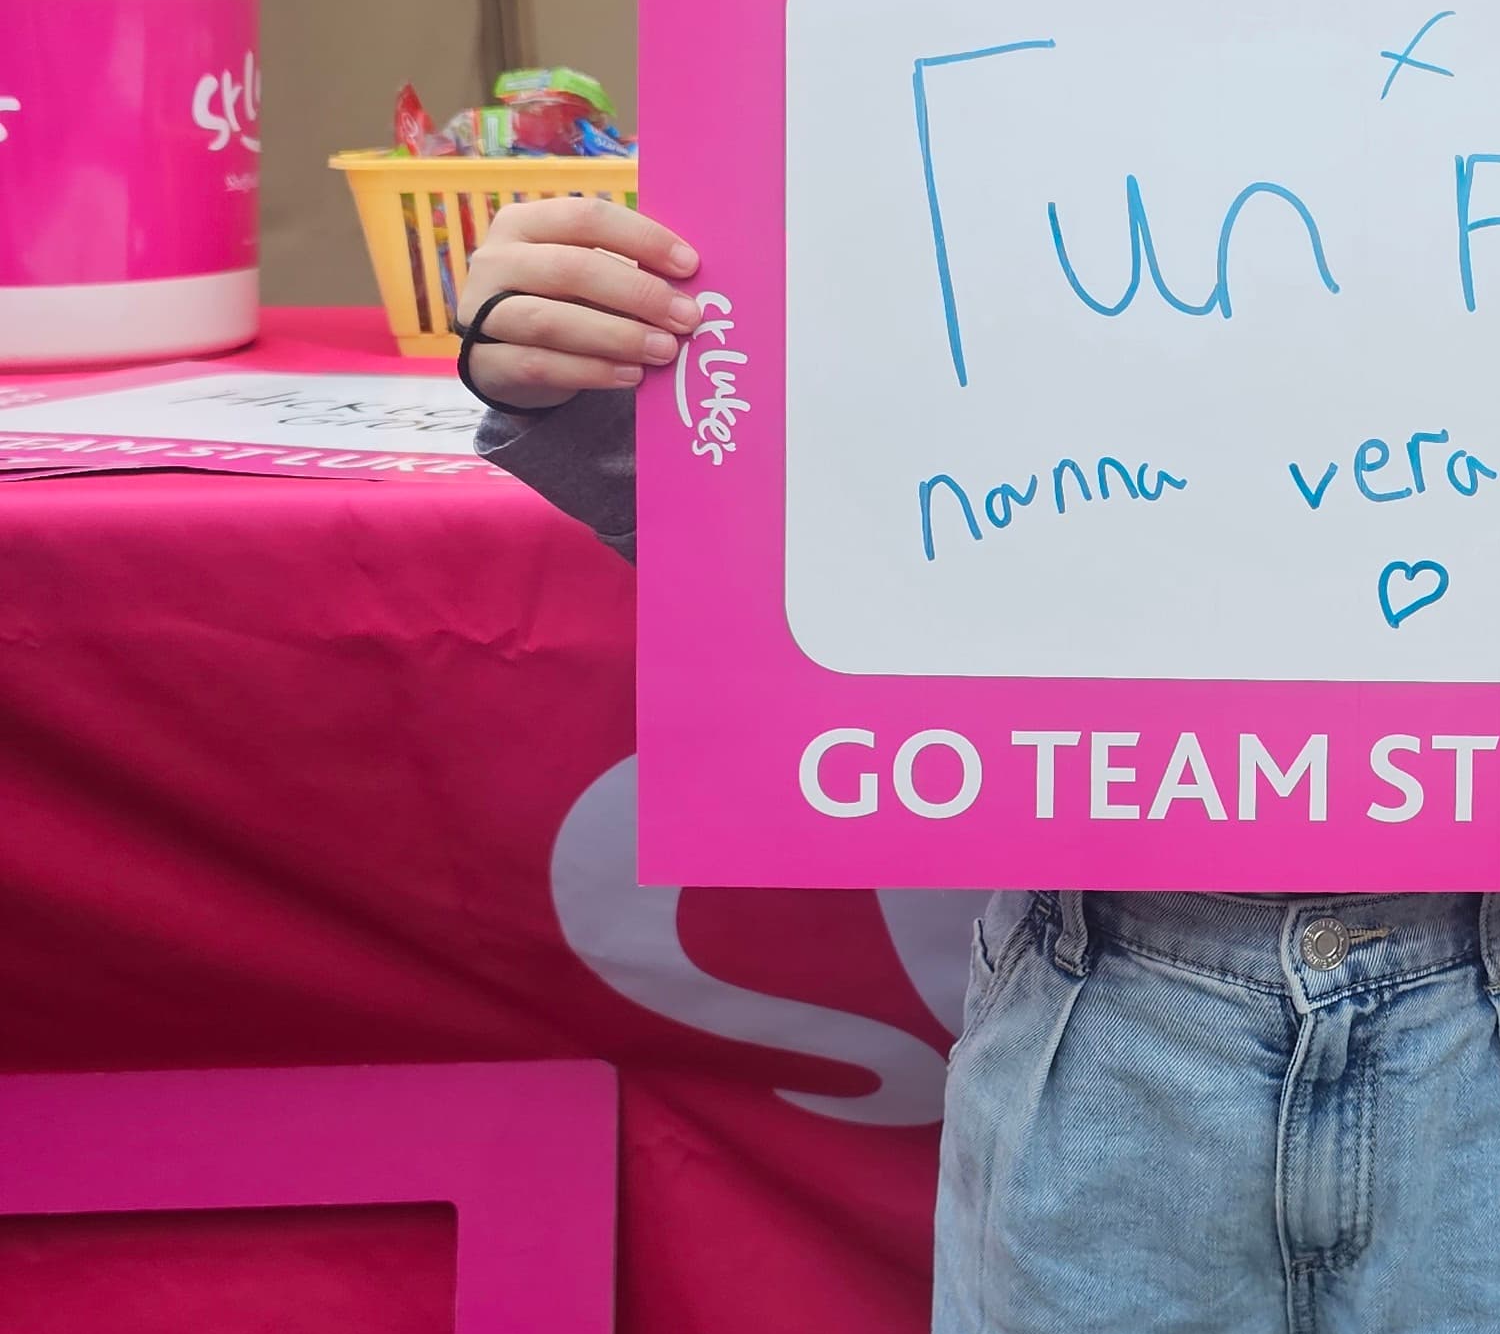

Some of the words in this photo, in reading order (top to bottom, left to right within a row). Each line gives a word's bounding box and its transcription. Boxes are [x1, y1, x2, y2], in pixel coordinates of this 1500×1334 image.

[798, 727, 983, 819] GO
[1011, 730, 1329, 822] TEAM
[1366, 733, 1500, 823] ST
